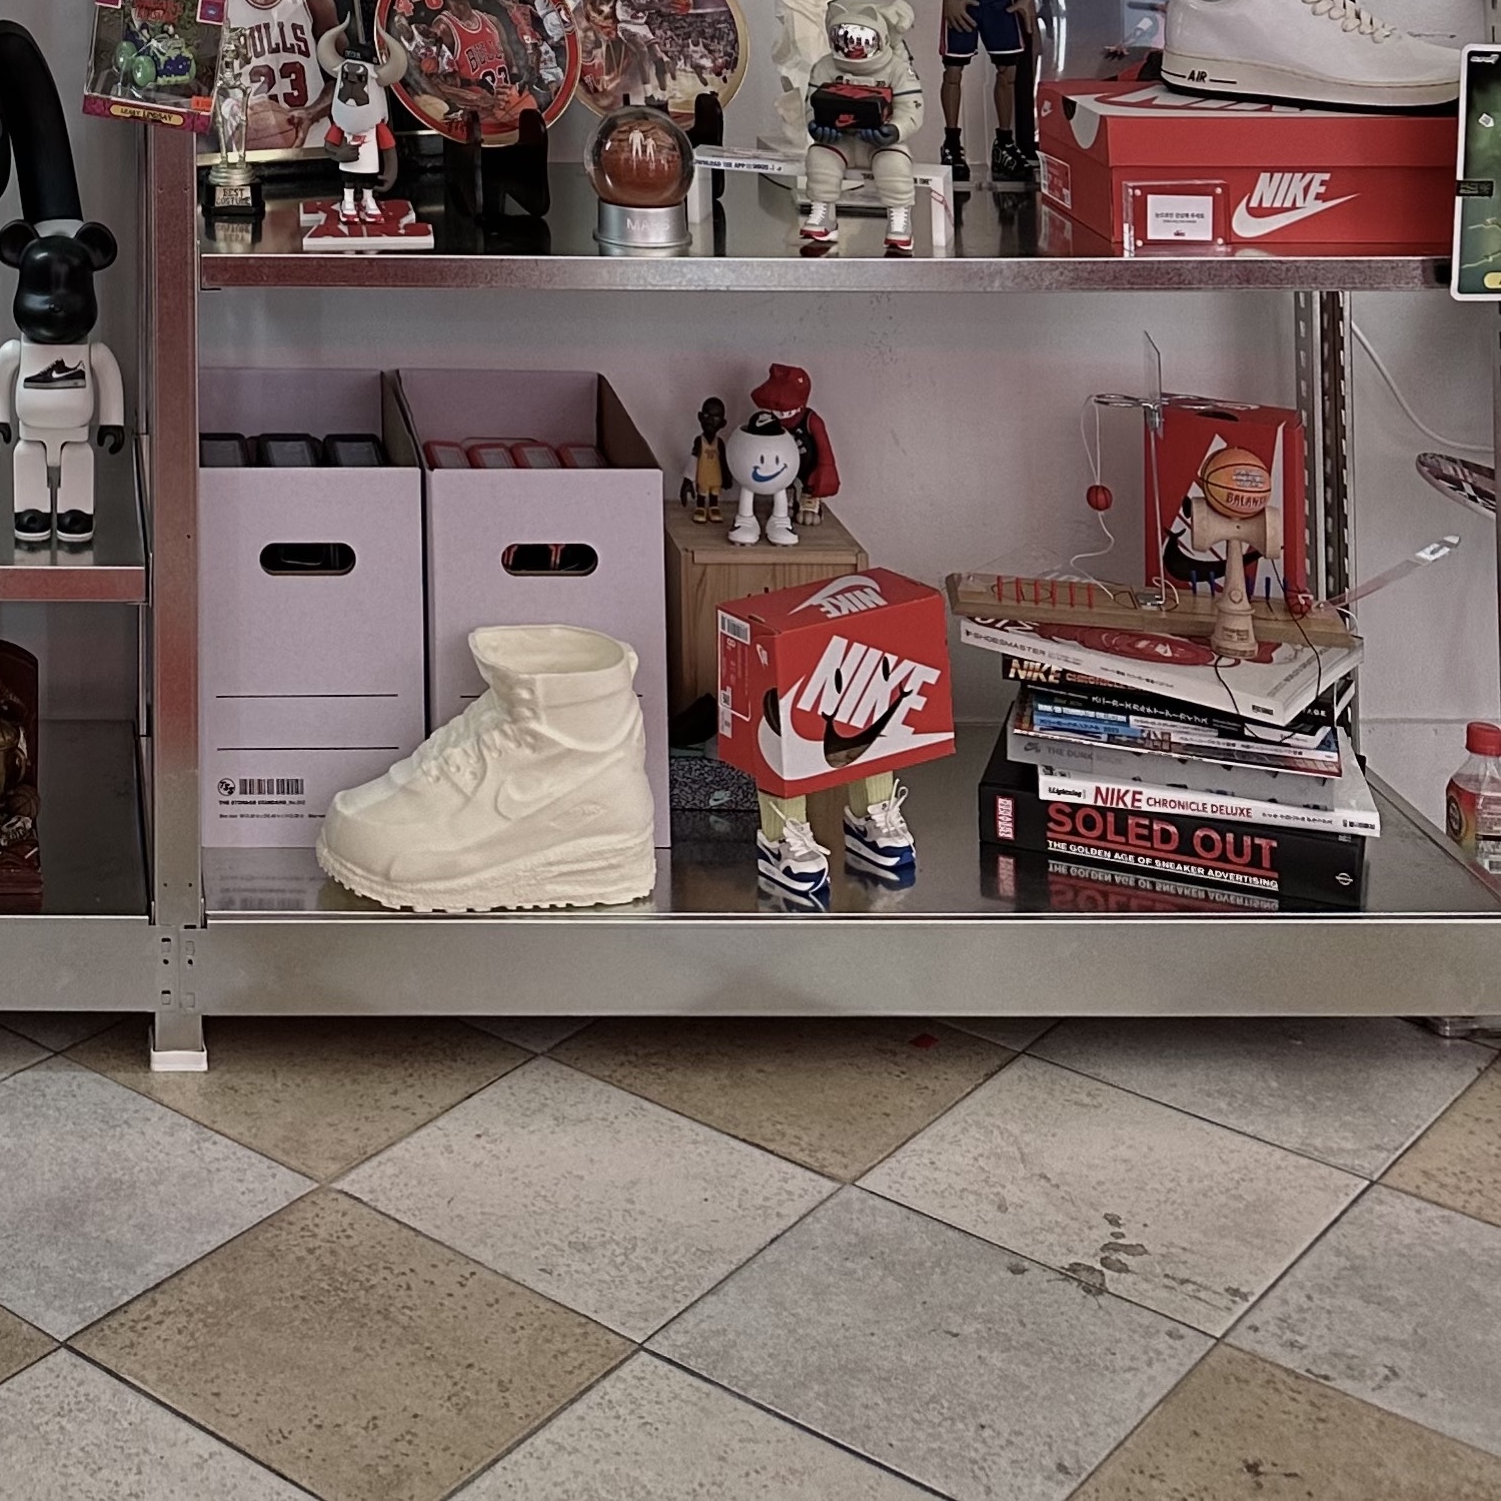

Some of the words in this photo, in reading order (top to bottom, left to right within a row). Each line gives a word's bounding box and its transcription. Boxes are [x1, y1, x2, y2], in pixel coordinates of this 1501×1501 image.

[246, 21, 311, 59] ULLS
[249, 61, 309, 108] 23
[1187, 70, 1208, 84] AIR
[222, 188, 246, 197] BEST
[1249, 172, 1331, 208] NIKE
[626, 217, 670, 231] MARS
[819, 587, 888, 619] NIKE
[973, 632, 1046, 657] SHOESMASTER
[796, 634, 941, 735] NIKE
[1009, 658, 1063, 685] NIKE
[1093, 786, 1143, 809] NIKE
[1147, 797, 1208, 813] CHRONICLE
[1211, 804, 1253, 819] DELUXE
[1047, 802, 1180, 851] SOLED
[1193, 828, 1278, 869] OUT
[1047, 840, 1068, 850] THE
[1069, 844, 1111, 859] GOLDEN
[1114, 851, 1135, 863] AGE
[1137, 855, 1152, 865] OF
[1155, 858, 1205, 878] SNEAKER
[1207, 867, 1278, 890] ADVERTISING
